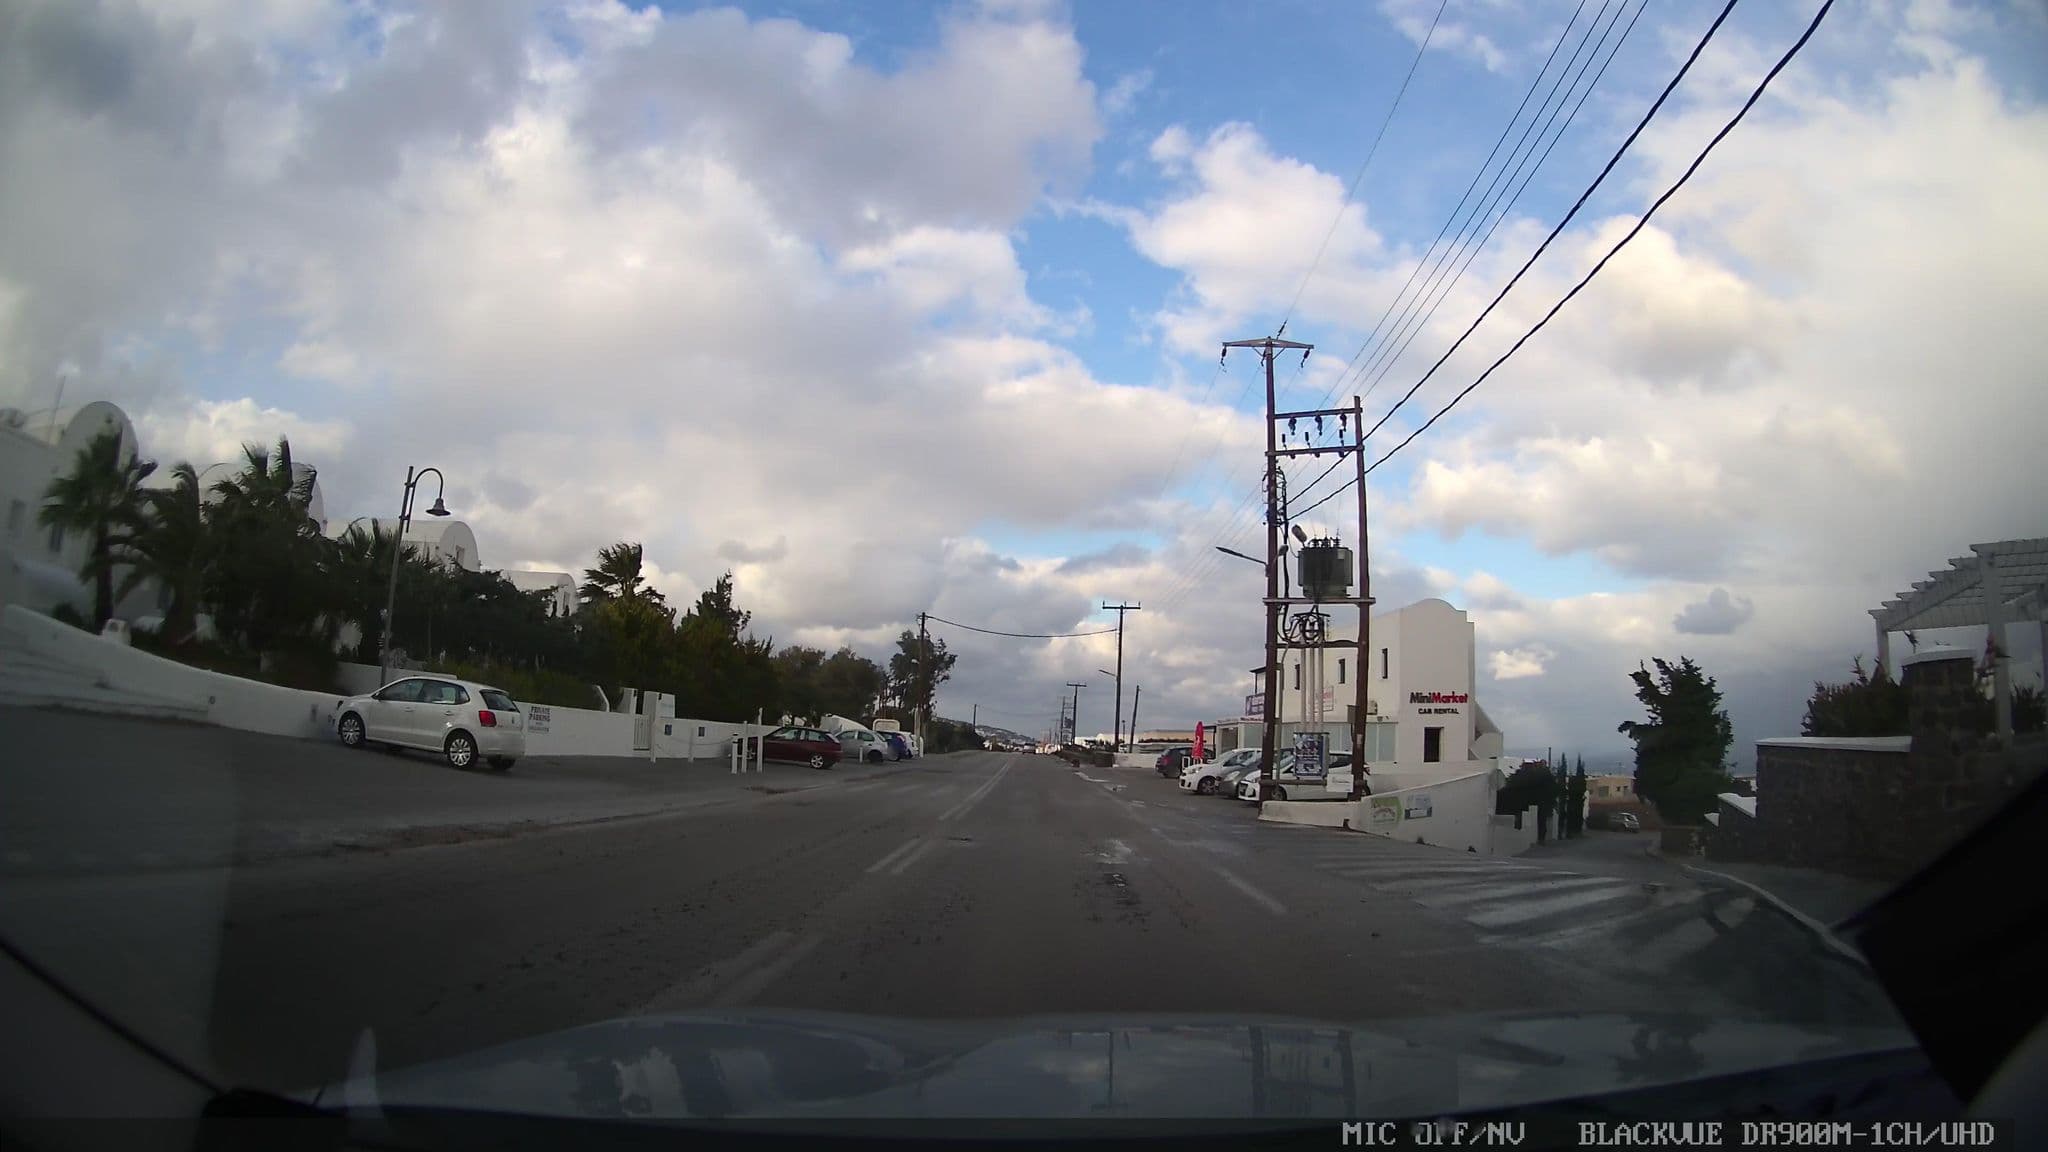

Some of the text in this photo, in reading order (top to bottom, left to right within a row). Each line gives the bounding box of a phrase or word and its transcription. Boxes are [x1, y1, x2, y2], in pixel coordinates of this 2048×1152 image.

[1409, 690, 1468, 704] MiniMarket
[1417, 707, 1460, 715] CAR RENTAL
[529, 713, 550, 722] PARKING
